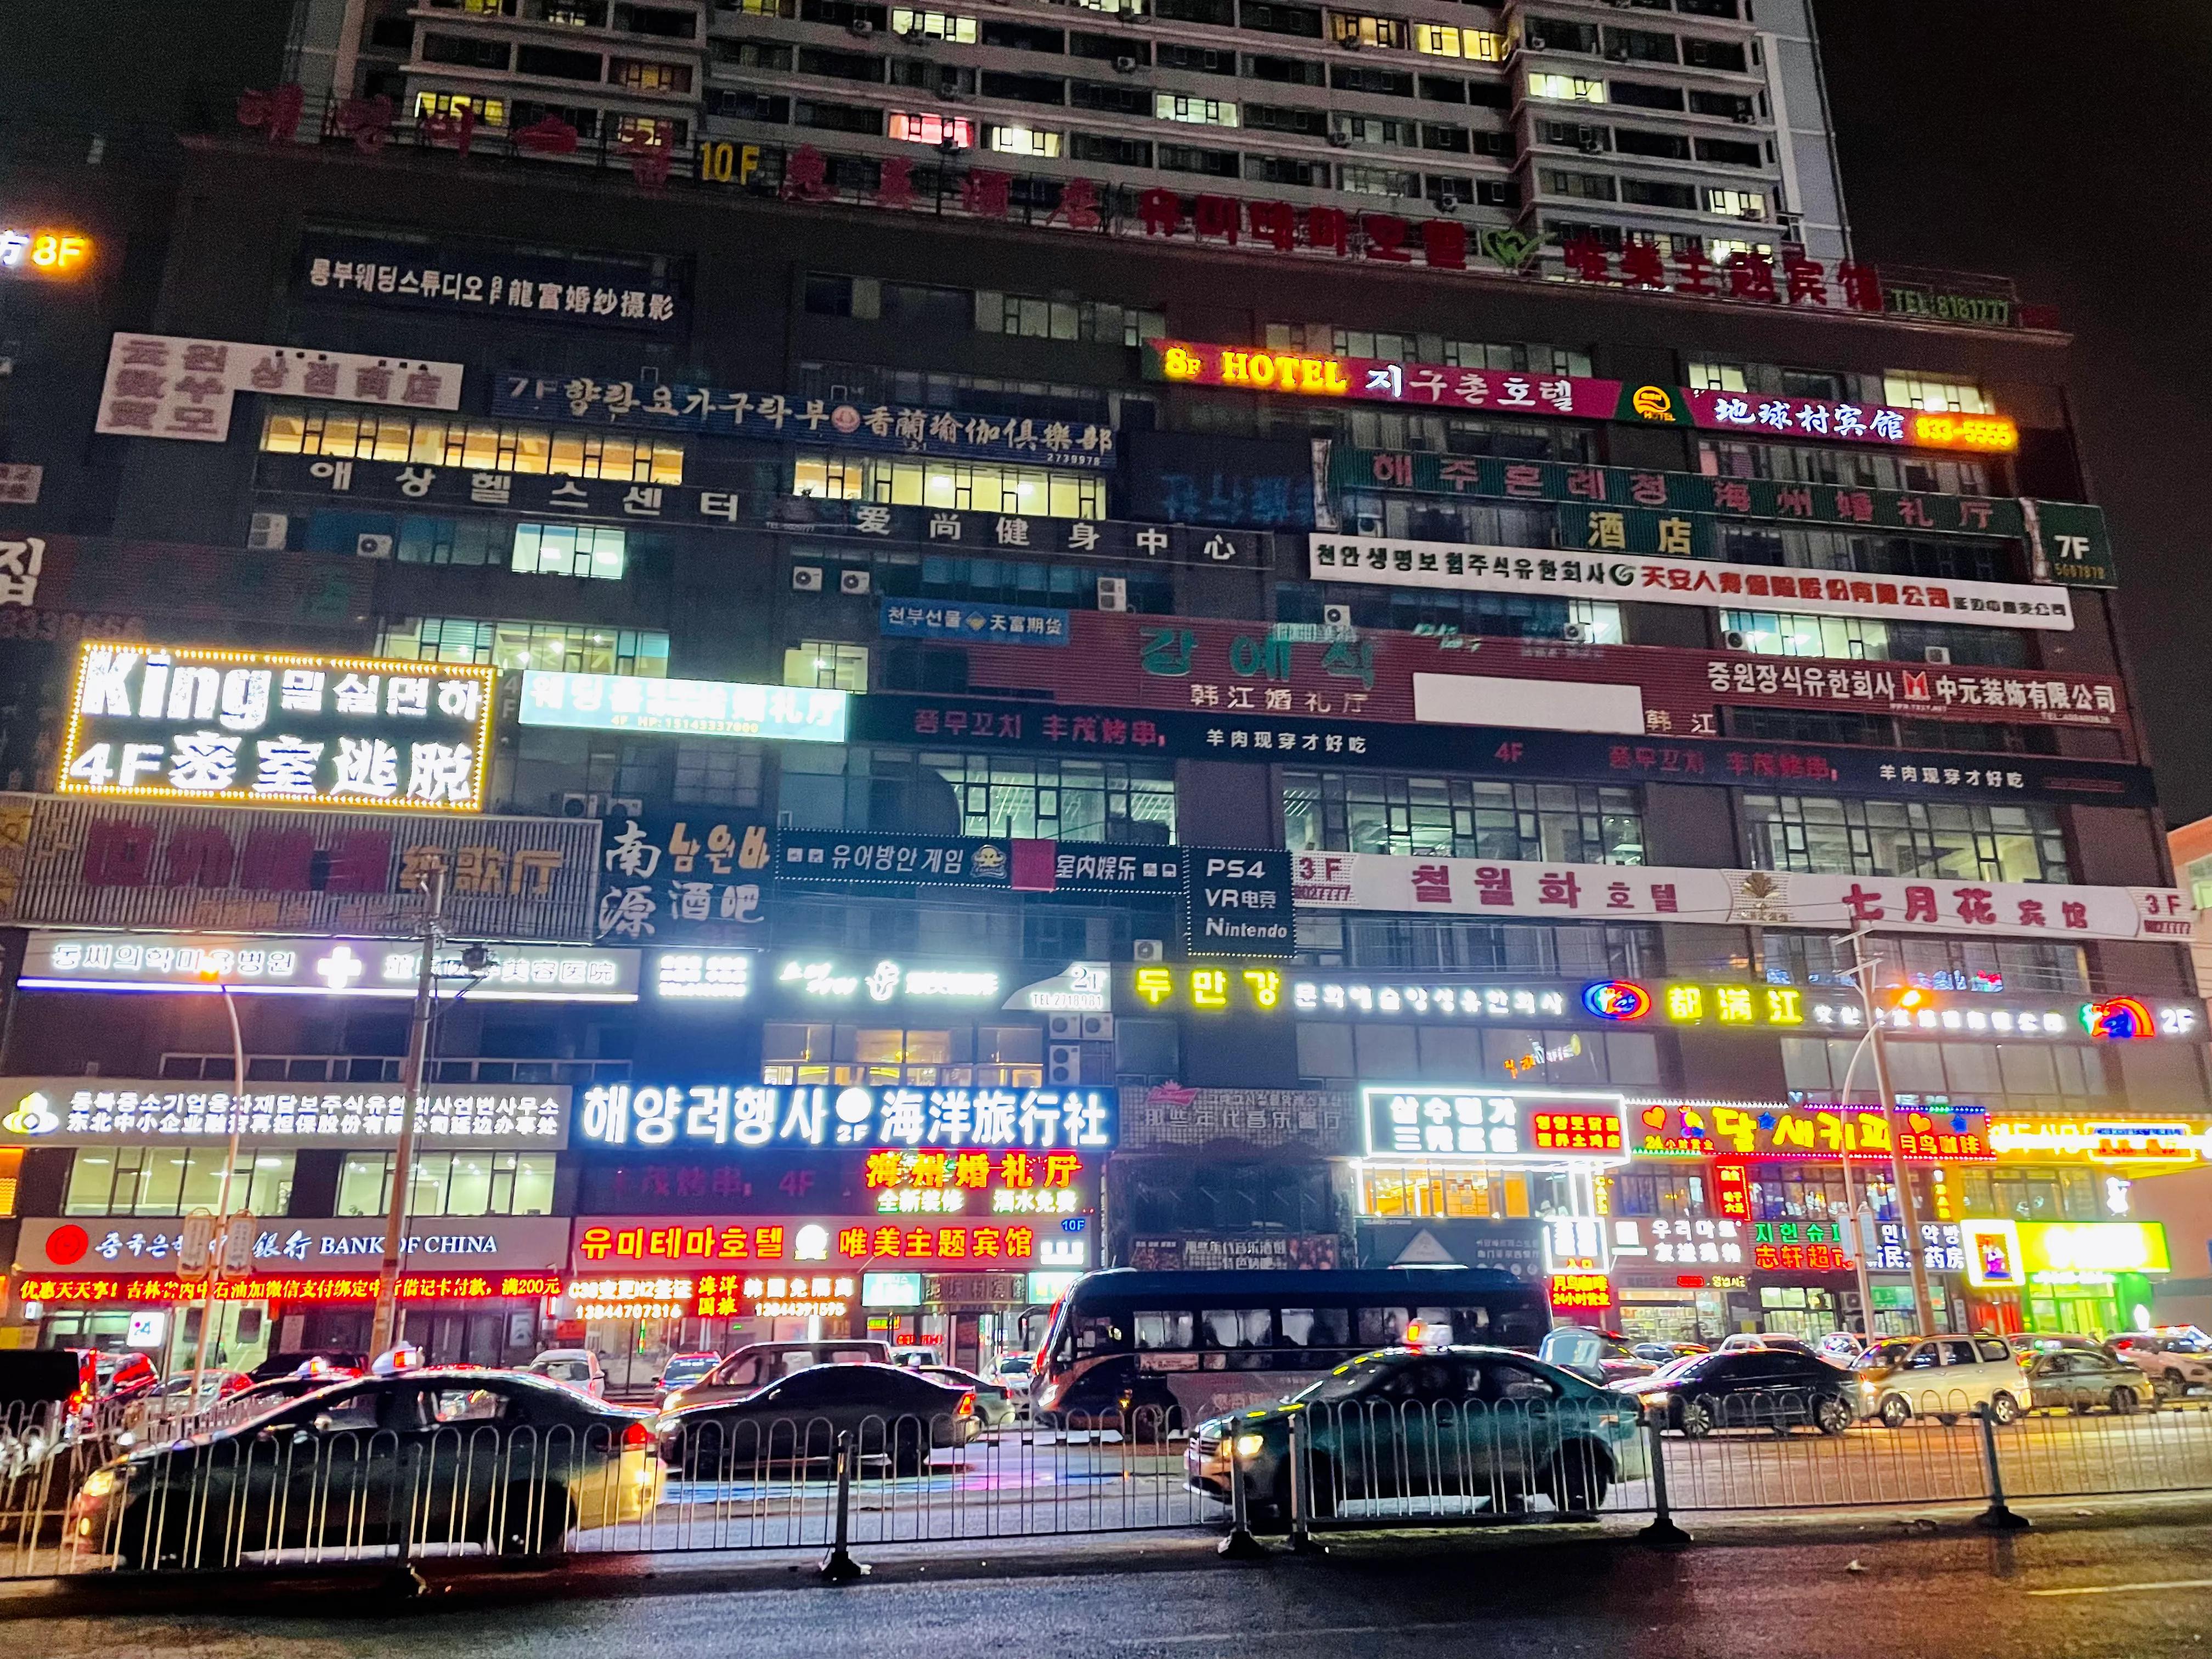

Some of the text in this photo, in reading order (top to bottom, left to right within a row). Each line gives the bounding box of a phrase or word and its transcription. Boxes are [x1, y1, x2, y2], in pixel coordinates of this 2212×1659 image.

[33, 234, 85, 267] 8F
[1221, 351, 1347, 393] HOTEL
[1713, 398, 1905, 441] 地球村宾馆
[309, 461, 1236, 561] 애상헬스센터 爱尚健身中心
[1588, 510, 1692, 555] 酒店
[2054, 535, 2091, 560] 7F
[887, 606, 1063, 636] 천부선물 天富期货
[81, 650, 272, 731] King
[1190, 684, 1369, 714] 韩江婚礼厅
[1707, 661, 2117, 714] 중원장식유한회사 中元装饰有限公司
[70, 730, 473, 801] 4F 密室逃脱
[1207, 859, 1266, 879] PS4
[1206, 917, 1288, 939] Nintendo
[1136, 967, 1280, 1008] 두만강
[2160, 1008, 2193, 1033] 2F
[583, 1085, 1108, 1148] 해양려행사 海洋旅行社
[836, 1124, 870, 1143] 2F
[580, 1224, 785, 1260] 유미테마호텔
[839, 1226, 1034, 1259] 唯美主题宾馆
[1061, 1218, 1086, 1232] 10F
[319, 1237, 386, 1255] BANK
[424, 1235, 498, 1254] CHINA
